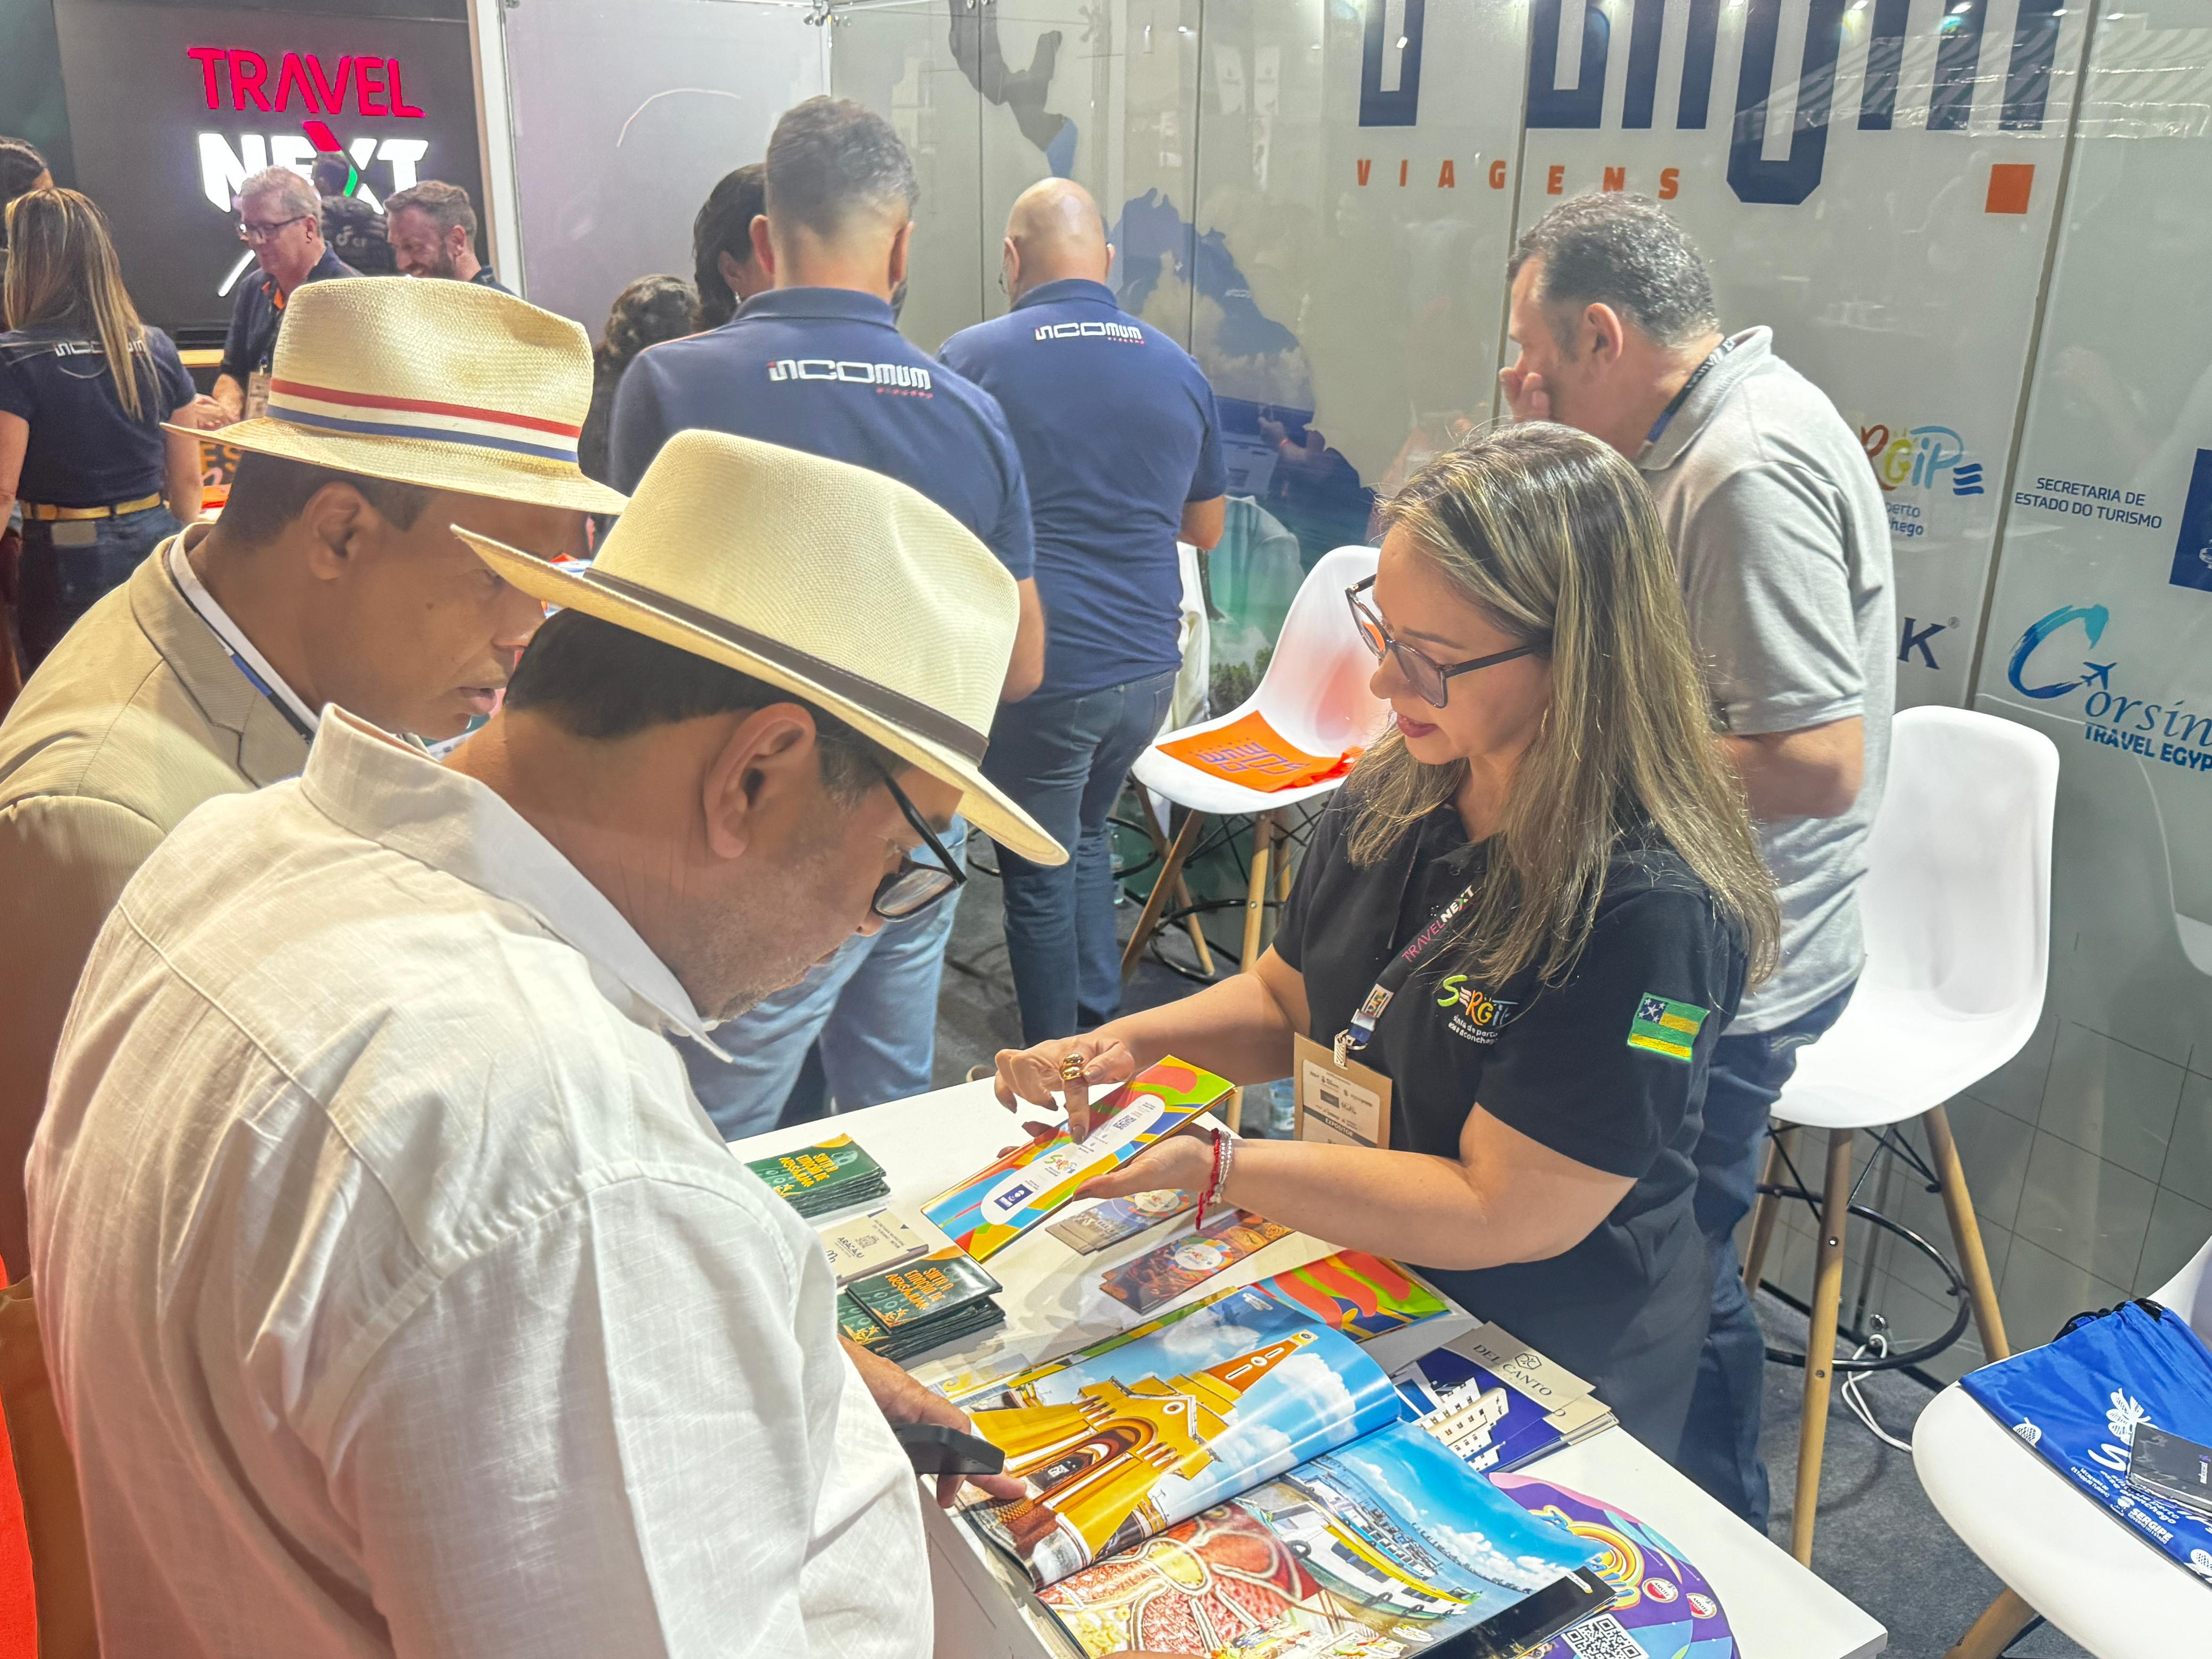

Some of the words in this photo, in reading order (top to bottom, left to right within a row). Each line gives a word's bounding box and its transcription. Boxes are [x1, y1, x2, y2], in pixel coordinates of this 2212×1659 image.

[187, 47, 426, 118] TRAVEL
[198, 121, 429, 214] NEXT
[1356, 159, 1679, 200] VIAGENS
[2014, 492, 2069, 512] ESTADO
[2072, 502, 2093, 517] DO
[2097, 506, 2163, 529] TURISMO
[2036, 477, 2121, 502] SECRETARIA
[2125, 492, 2146, 506] DE
[2085, 722, 2155, 758] TRAVEL
[2160, 743, 2212, 772] EGYP
[1503, 1363, 1552, 1396] CANTO
[2130, 1508, 2174, 1541] SERGIPE
